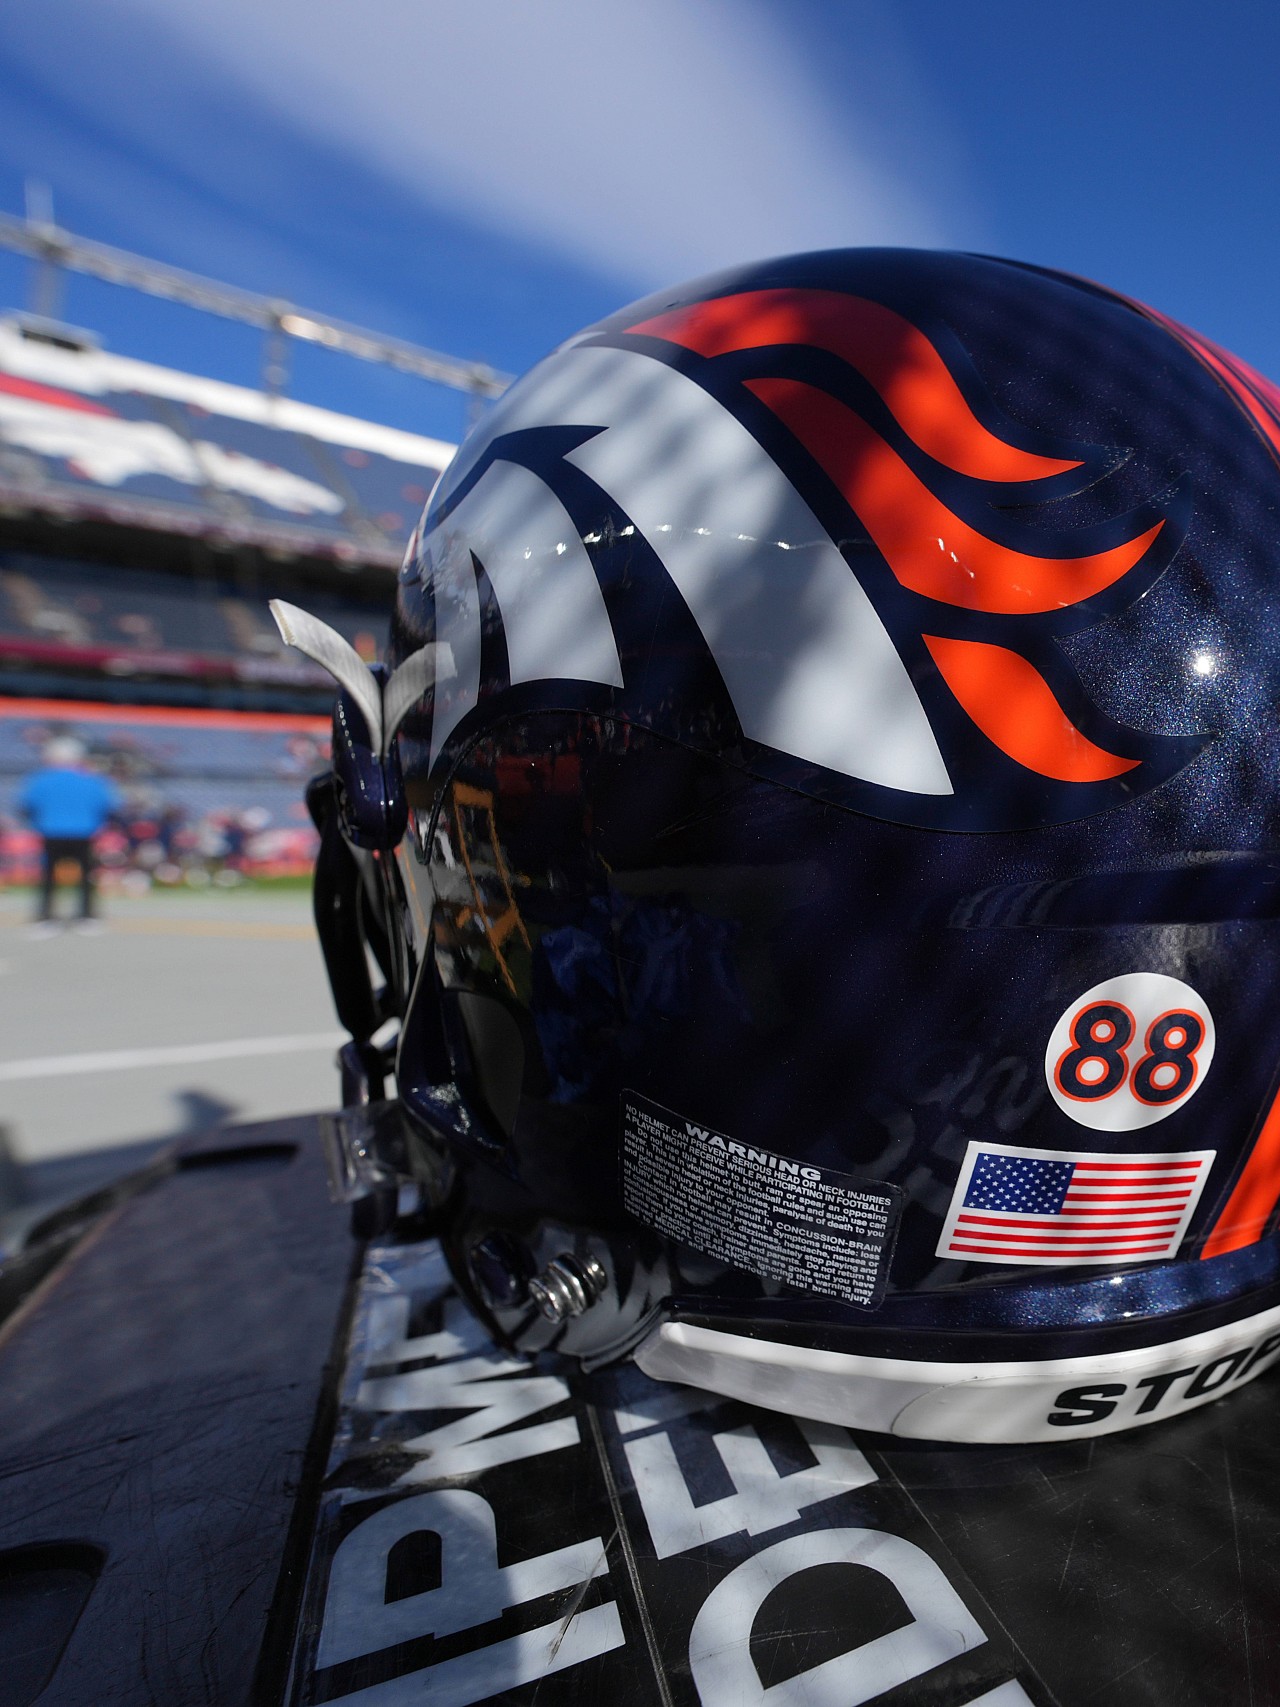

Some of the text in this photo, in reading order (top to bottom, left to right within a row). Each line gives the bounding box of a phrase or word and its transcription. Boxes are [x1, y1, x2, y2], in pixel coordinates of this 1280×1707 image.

[1053, 1000, 1206, 1107] 88
[624, 1145, 638, 1157] and
[639, 1154, 670, 1176] possible
[672, 1171, 694, 1189] injury
[695, 1183, 704, 1192] to
[705, 1188, 725, 1200] your
[625, 1137, 645, 1154] result
[646, 1149, 653, 1159] in
[655, 1155, 680, 1173] severe
[682, 1168, 702, 1183] head
[703, 1179, 712, 1187] or
[714, 1184, 734, 1196] neck
[773, 1205, 814, 1222] paralysis
[827, 1220, 854, 1232] death
[866, 1230, 885, 1238] you
[626, 1103, 892, 1206] NO HELMET CAN PREVENT SERIOUS HEAD OR NECK INJURIES
[626, 1112, 631, 1121] A
[632, 1116, 661, 1138] PLAYER
[662, 1133, 688, 1151] MIGHT
[689, 1146, 725, 1167] RECEIVE
[726, 1162, 755, 1178] WHILE
[756, 1173, 824, 1200] PARTICIPATING
[825, 1194, 835, 1203] IN
[638, 1127, 648, 1139] Do
[650, 1136, 663, 1147] not
[665, 1144, 680, 1156] use
[682, 1152, 698, 1164] this
[700, 1160, 730, 1178] helmet
[731, 1173, 740, 1182] to
[766, 1187, 784, 1197] ram
[786, 1193, 797, 1201] or
[799, 1197, 826, 1209] spear
[828, 1205, 841, 1213] an
[843, 1209, 888, 1224] opposing
[651, 1144, 667, 1158] This
[669, 1153, 676, 1162] is
[678, 1158, 685, 1167] in
[686, 1163, 721, 1182] violation
[722, 1179, 732, 1187] of
[733, 1182, 747, 1192] the
[748, 1187, 782, 1204] football
[783, 1200, 806, 1211] rules
[807, 1208, 825, 1217] and
[826, 1213, 849, 1223] such
[850, 1219, 868, 1227] use
[685, 1121, 822, 1181] WARNING
[624, 1159, 652, 1181] INJURY
[653, 1178, 675, 1194] which
[677, 1190, 687, 1200] no
[688, 1195, 716, 1212] helmet
[717, 1209, 732, 1219] can
[773, 1228, 821, 1248] Symptoms
[860, 1251, 881, 1261] loss
[638, 1160, 882, 1254] Contact in football may result in CONCUSSION-BRAIN
[651, 1207, 658, 1215] or
[661, 1212, 691, 1231] practice
[693, 1228, 711, 1240] until
[713, 1237, 723, 1245] all
[725, 1242, 770, 1263] symptoms
[772, 1259, 786, 1268] are
[788, 1265, 811, 1275] gone
[813, 1272, 831, 1281] and
[832, 1277, 850, 1285] you
[852, 1280, 875, 1290] have
[665, 1206, 673, 1215] to
[674, 1212, 691, 1224] your
[720, 1232, 748, 1248] trainer
[749, 1244, 766, 1254] and
[806, 1261, 820, 1270] Do
[821, 1266, 836, 1274] not
[837, 1270, 865, 1280] return
[669, 1202, 684, 1213] you
[685, 1209, 704, 1223] have
[751, 1236, 803, 1260] immediately
[804, 1255, 825, 1266] stop
[825, 1261, 859, 1274] playing
[860, 1268, 878, 1276] and
[690, 1205, 699, 1213] or
[833, 1254, 867, 1266] nausea
[653, 1222, 685, 1243] another
[688, 1240, 704, 1252] and
[708, 1249, 730, 1263] more
[734, 1260, 768, 1277] serious
[772, 1274, 783, 1282] or
[786, 1277, 808, 1289] fatal
[812, 1285, 837, 1297] brain
[655, 1215, 692, 1239] MEDICAL
[757, 1260, 794, 1279] Ignoring
[796, 1273, 813, 1283] this
[815, 1279, 852, 1294] warning
[853, 1288, 874, 1298] may
